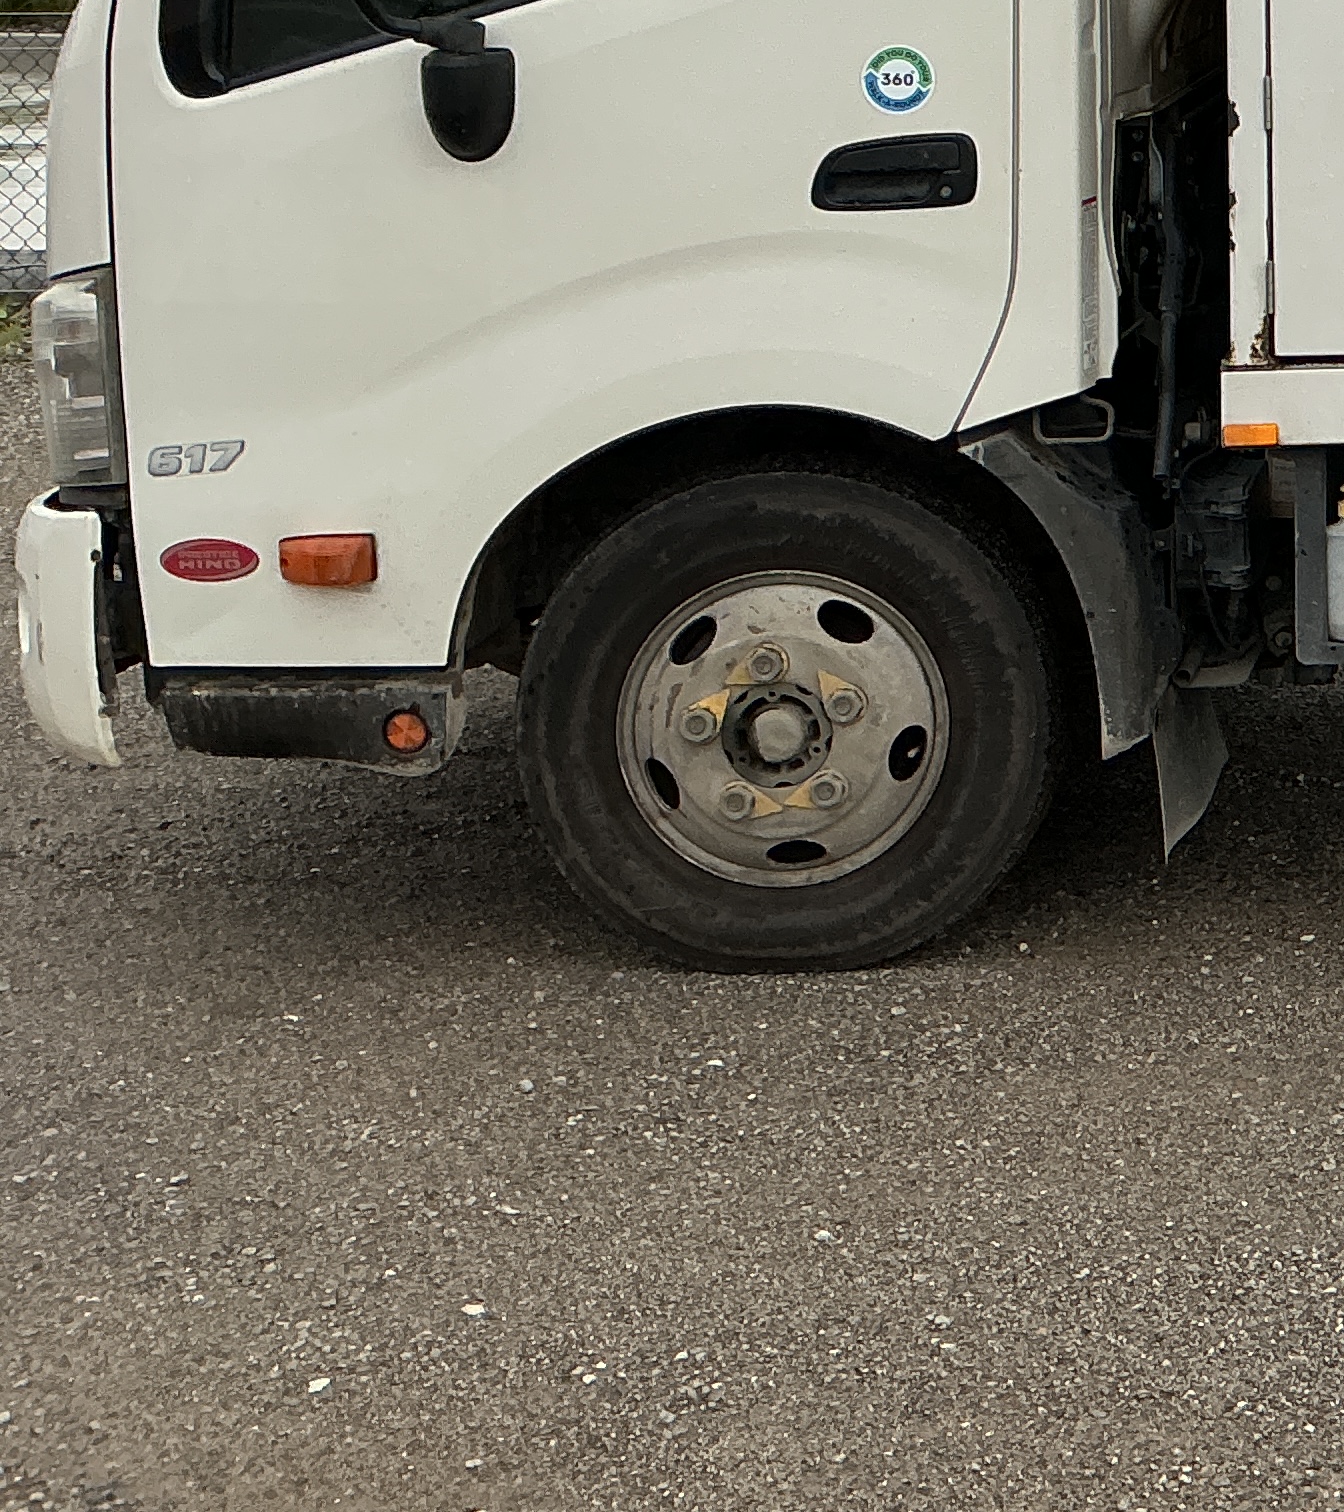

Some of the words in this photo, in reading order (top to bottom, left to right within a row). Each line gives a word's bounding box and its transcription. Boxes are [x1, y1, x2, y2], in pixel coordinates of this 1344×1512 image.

[885, 49, 904, 58] YOU
[905, 51, 918, 61] DO
[147, 439, 245, 477] 617
